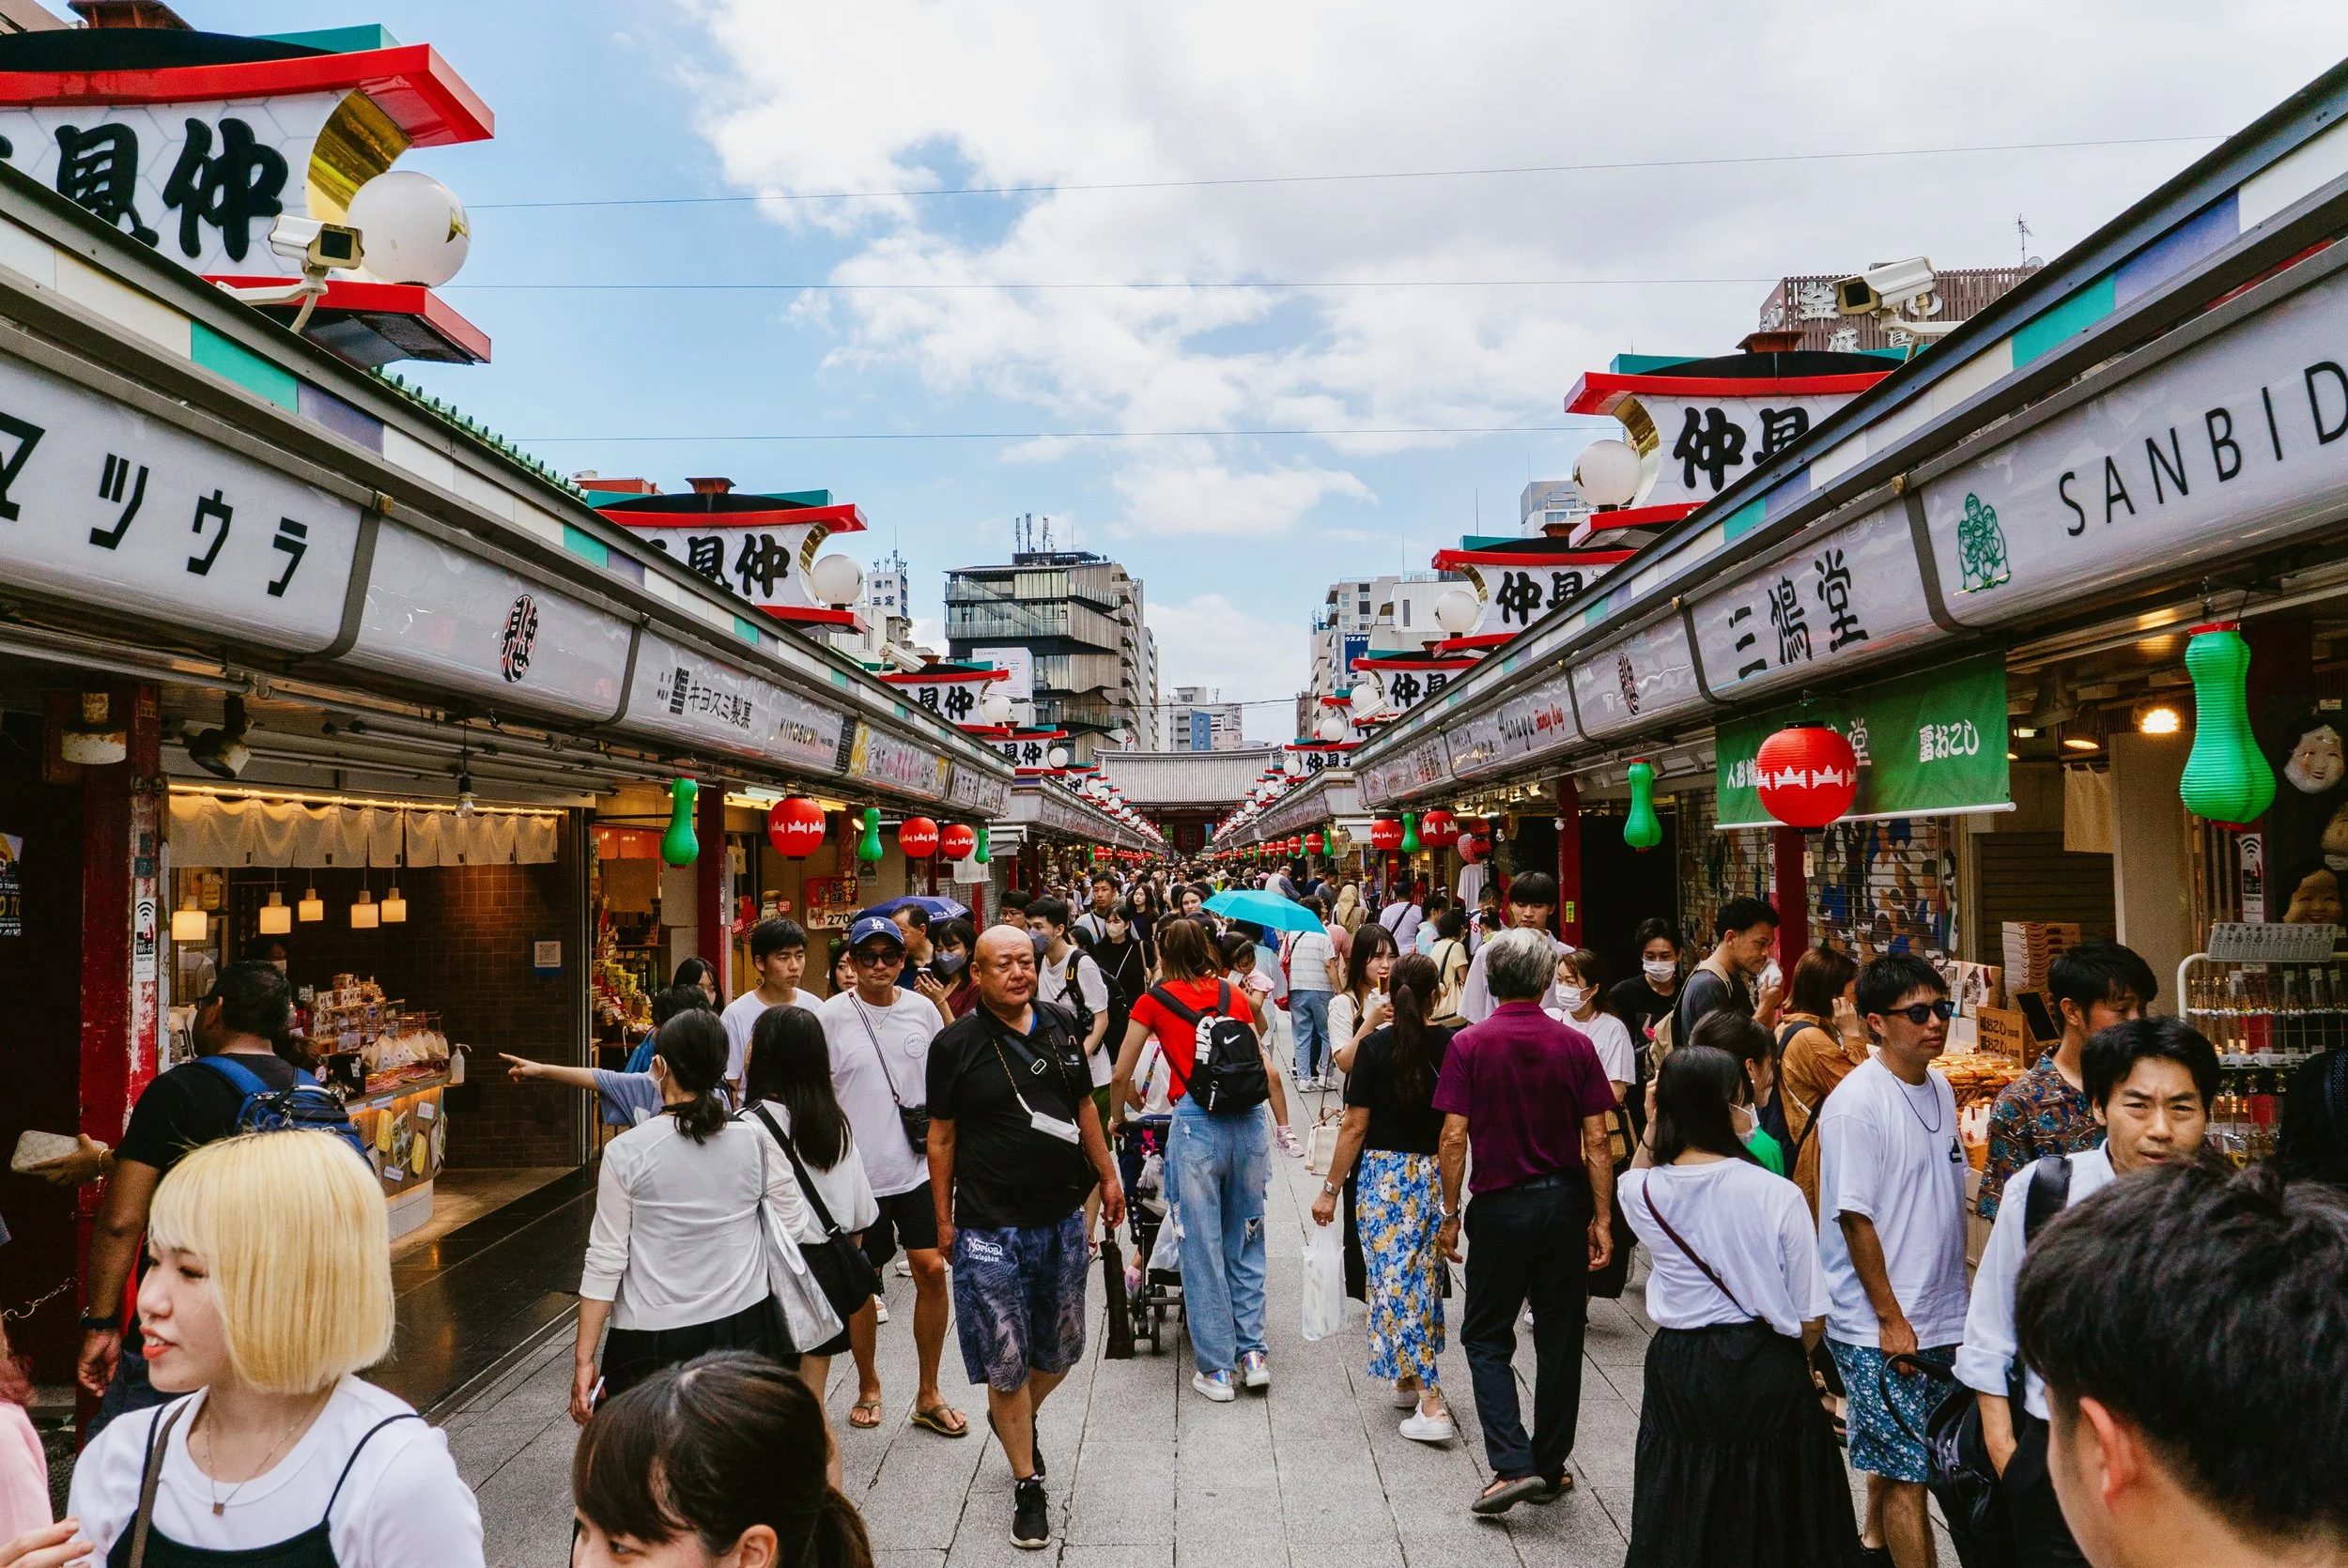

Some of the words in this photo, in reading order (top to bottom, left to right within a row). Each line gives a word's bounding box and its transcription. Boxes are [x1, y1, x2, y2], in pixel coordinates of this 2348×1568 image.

[2060, 361, 2348, 537] SANBID
[827, 913, 850, 926] 270
[137, 944, 154, 953] Wi-Fi
[967, 1237, 1003, 1255] Norton
